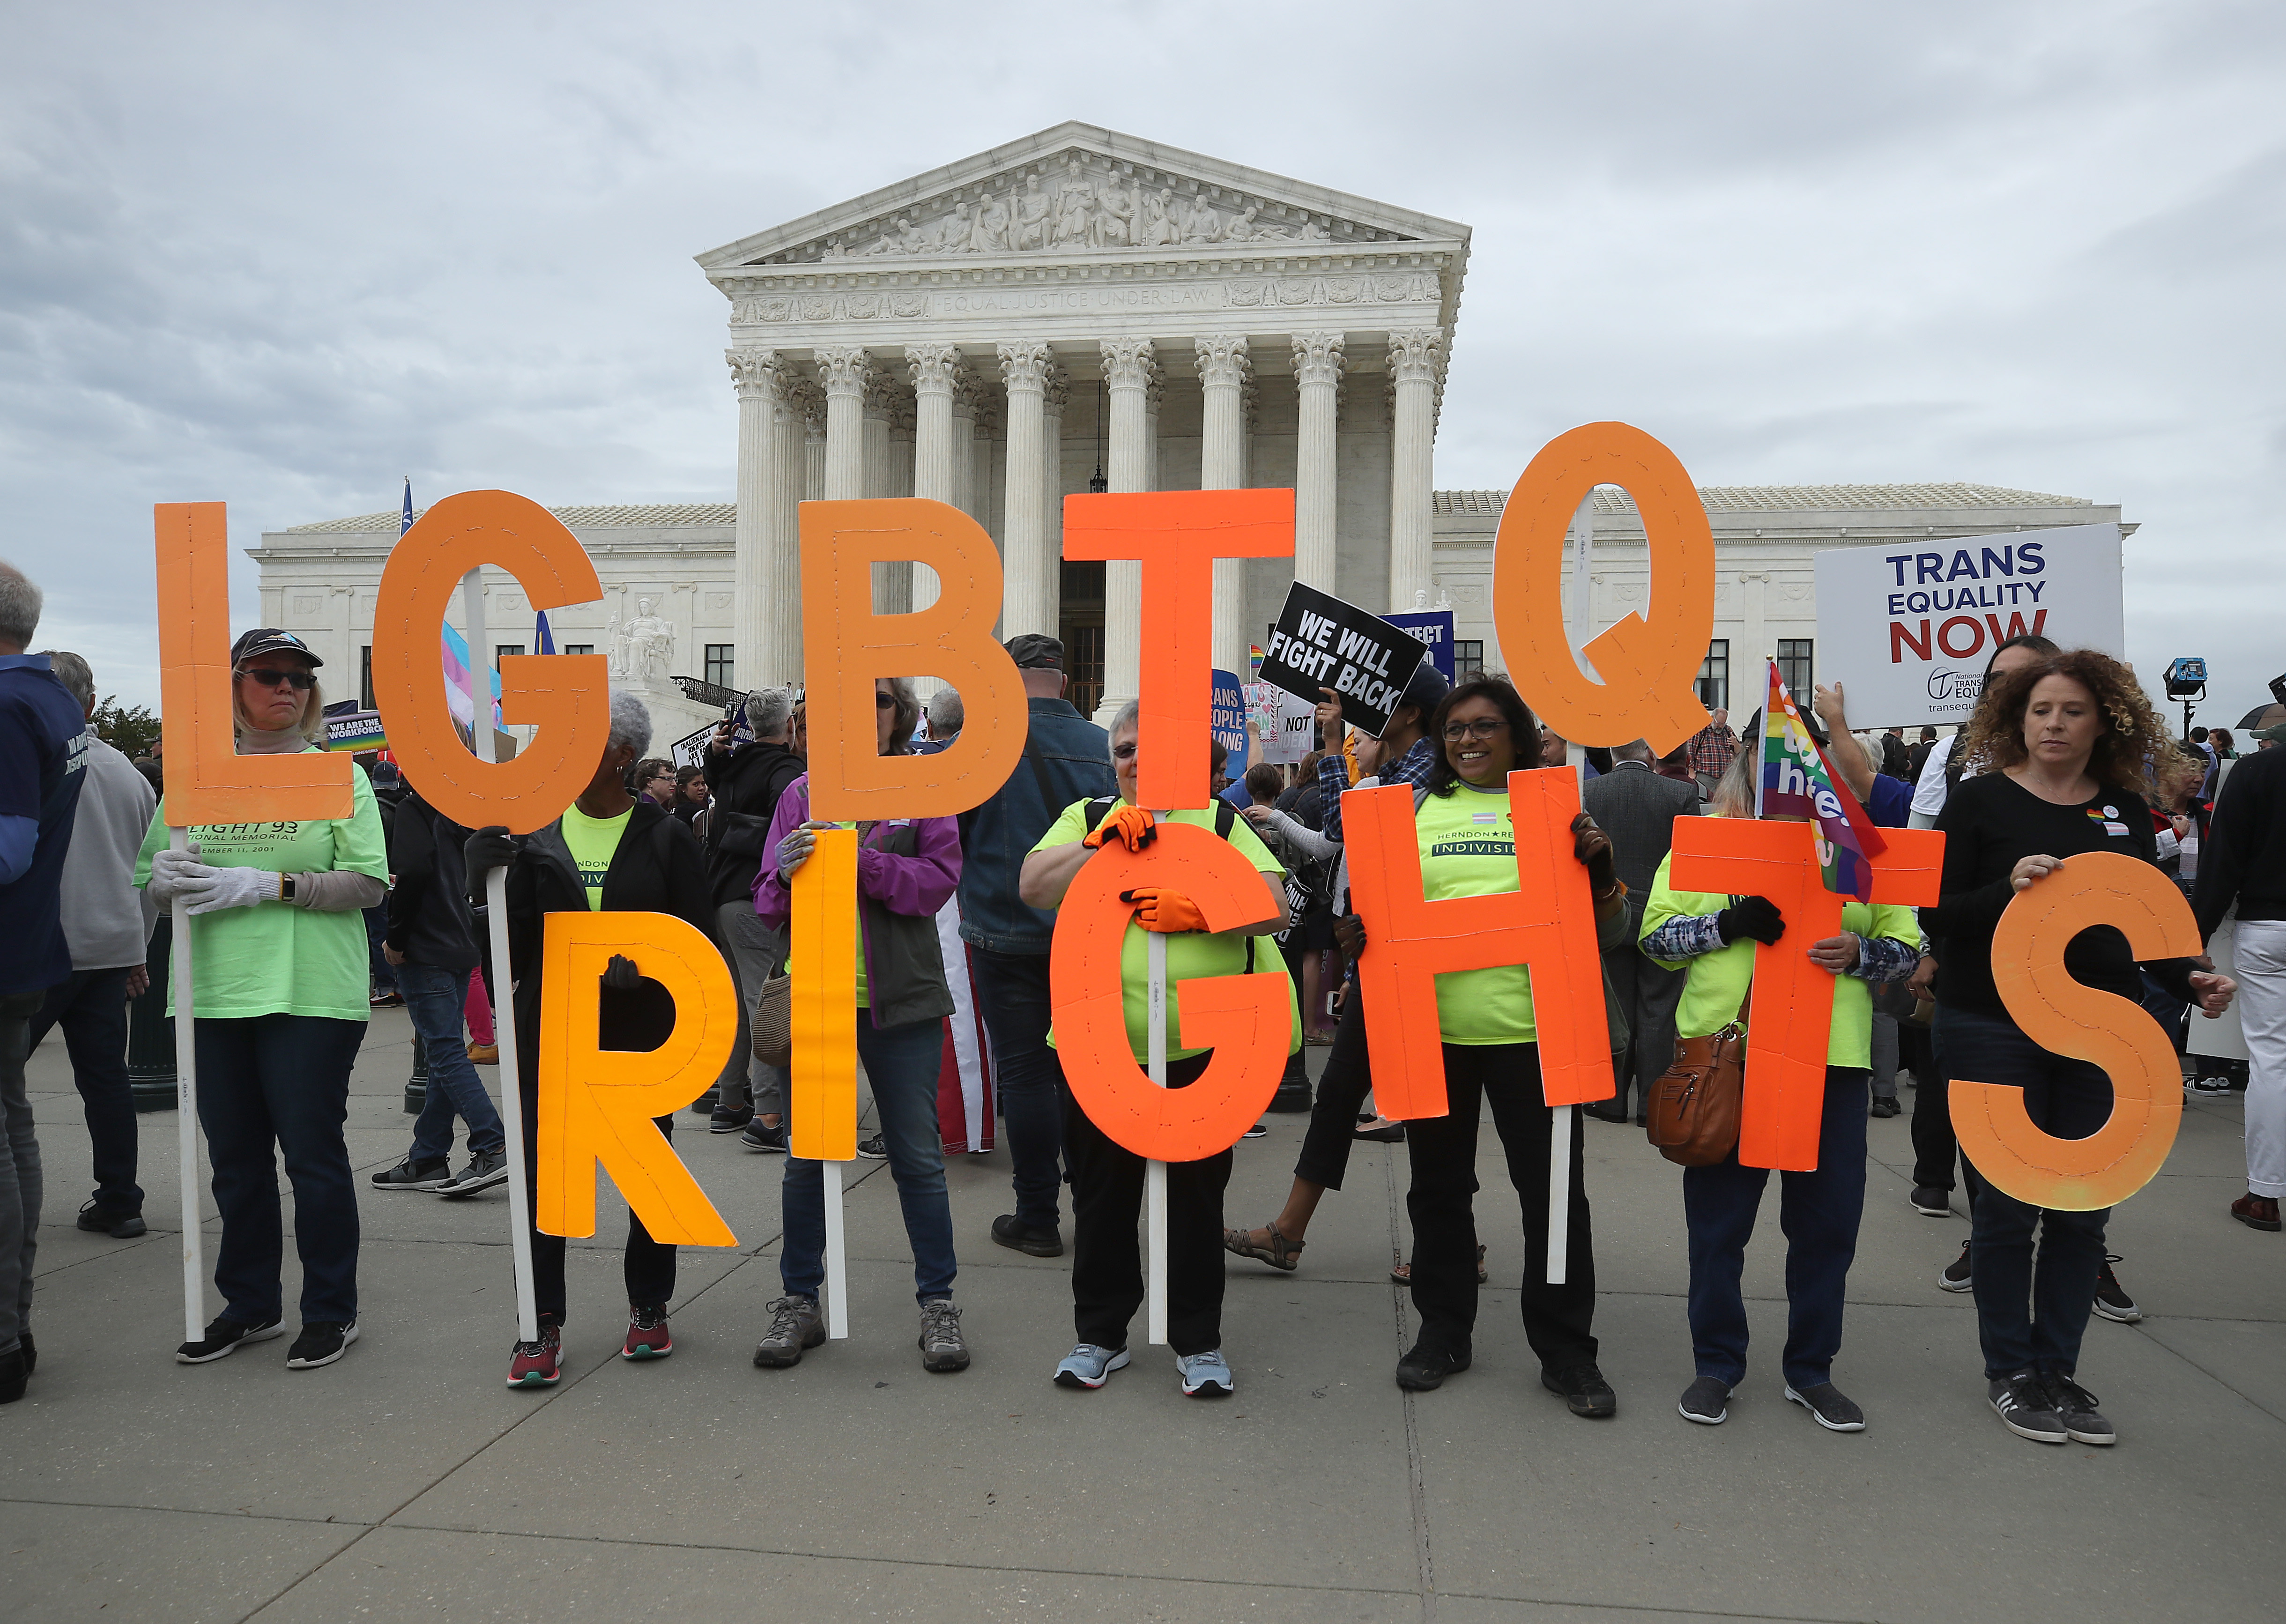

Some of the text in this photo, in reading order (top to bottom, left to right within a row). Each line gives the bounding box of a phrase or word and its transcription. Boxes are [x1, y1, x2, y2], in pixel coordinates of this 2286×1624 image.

[943, 288, 1209, 312] EQUAL JUSTICE UNDER LAW
[1886, 543, 2046, 586] TRANS
[1888, 581, 2047, 615] EQUALITY
[1399, 625, 1443, 644] TECT
[1890, 609, 2048, 663] NOW
[1298, 609, 1392, 678] WE WILL
[1267, 630, 1402, 715] FIGHT BACK
[1954, 679, 1983, 688] TRANS
[1210, 687, 1239, 708] ANS
[1244, 685, 1265, 702] ANS
[1955, 687, 1980, 698] EQU
[1929, 703, 1975, 712] transequ
[329, 718, 379, 731] WE ARE THE
[1210, 708, 1243, 730] OPLE
[1286, 716, 1311, 732] NOT
[328, 725, 384, 739] WORKFORCE
[688, 740, 705, 754] RIGHTS
[688, 751, 698, 762] ARE
[189, 821, 298, 834] LIGHT 93
[1438, 831, 1490, 840] HERNDON
